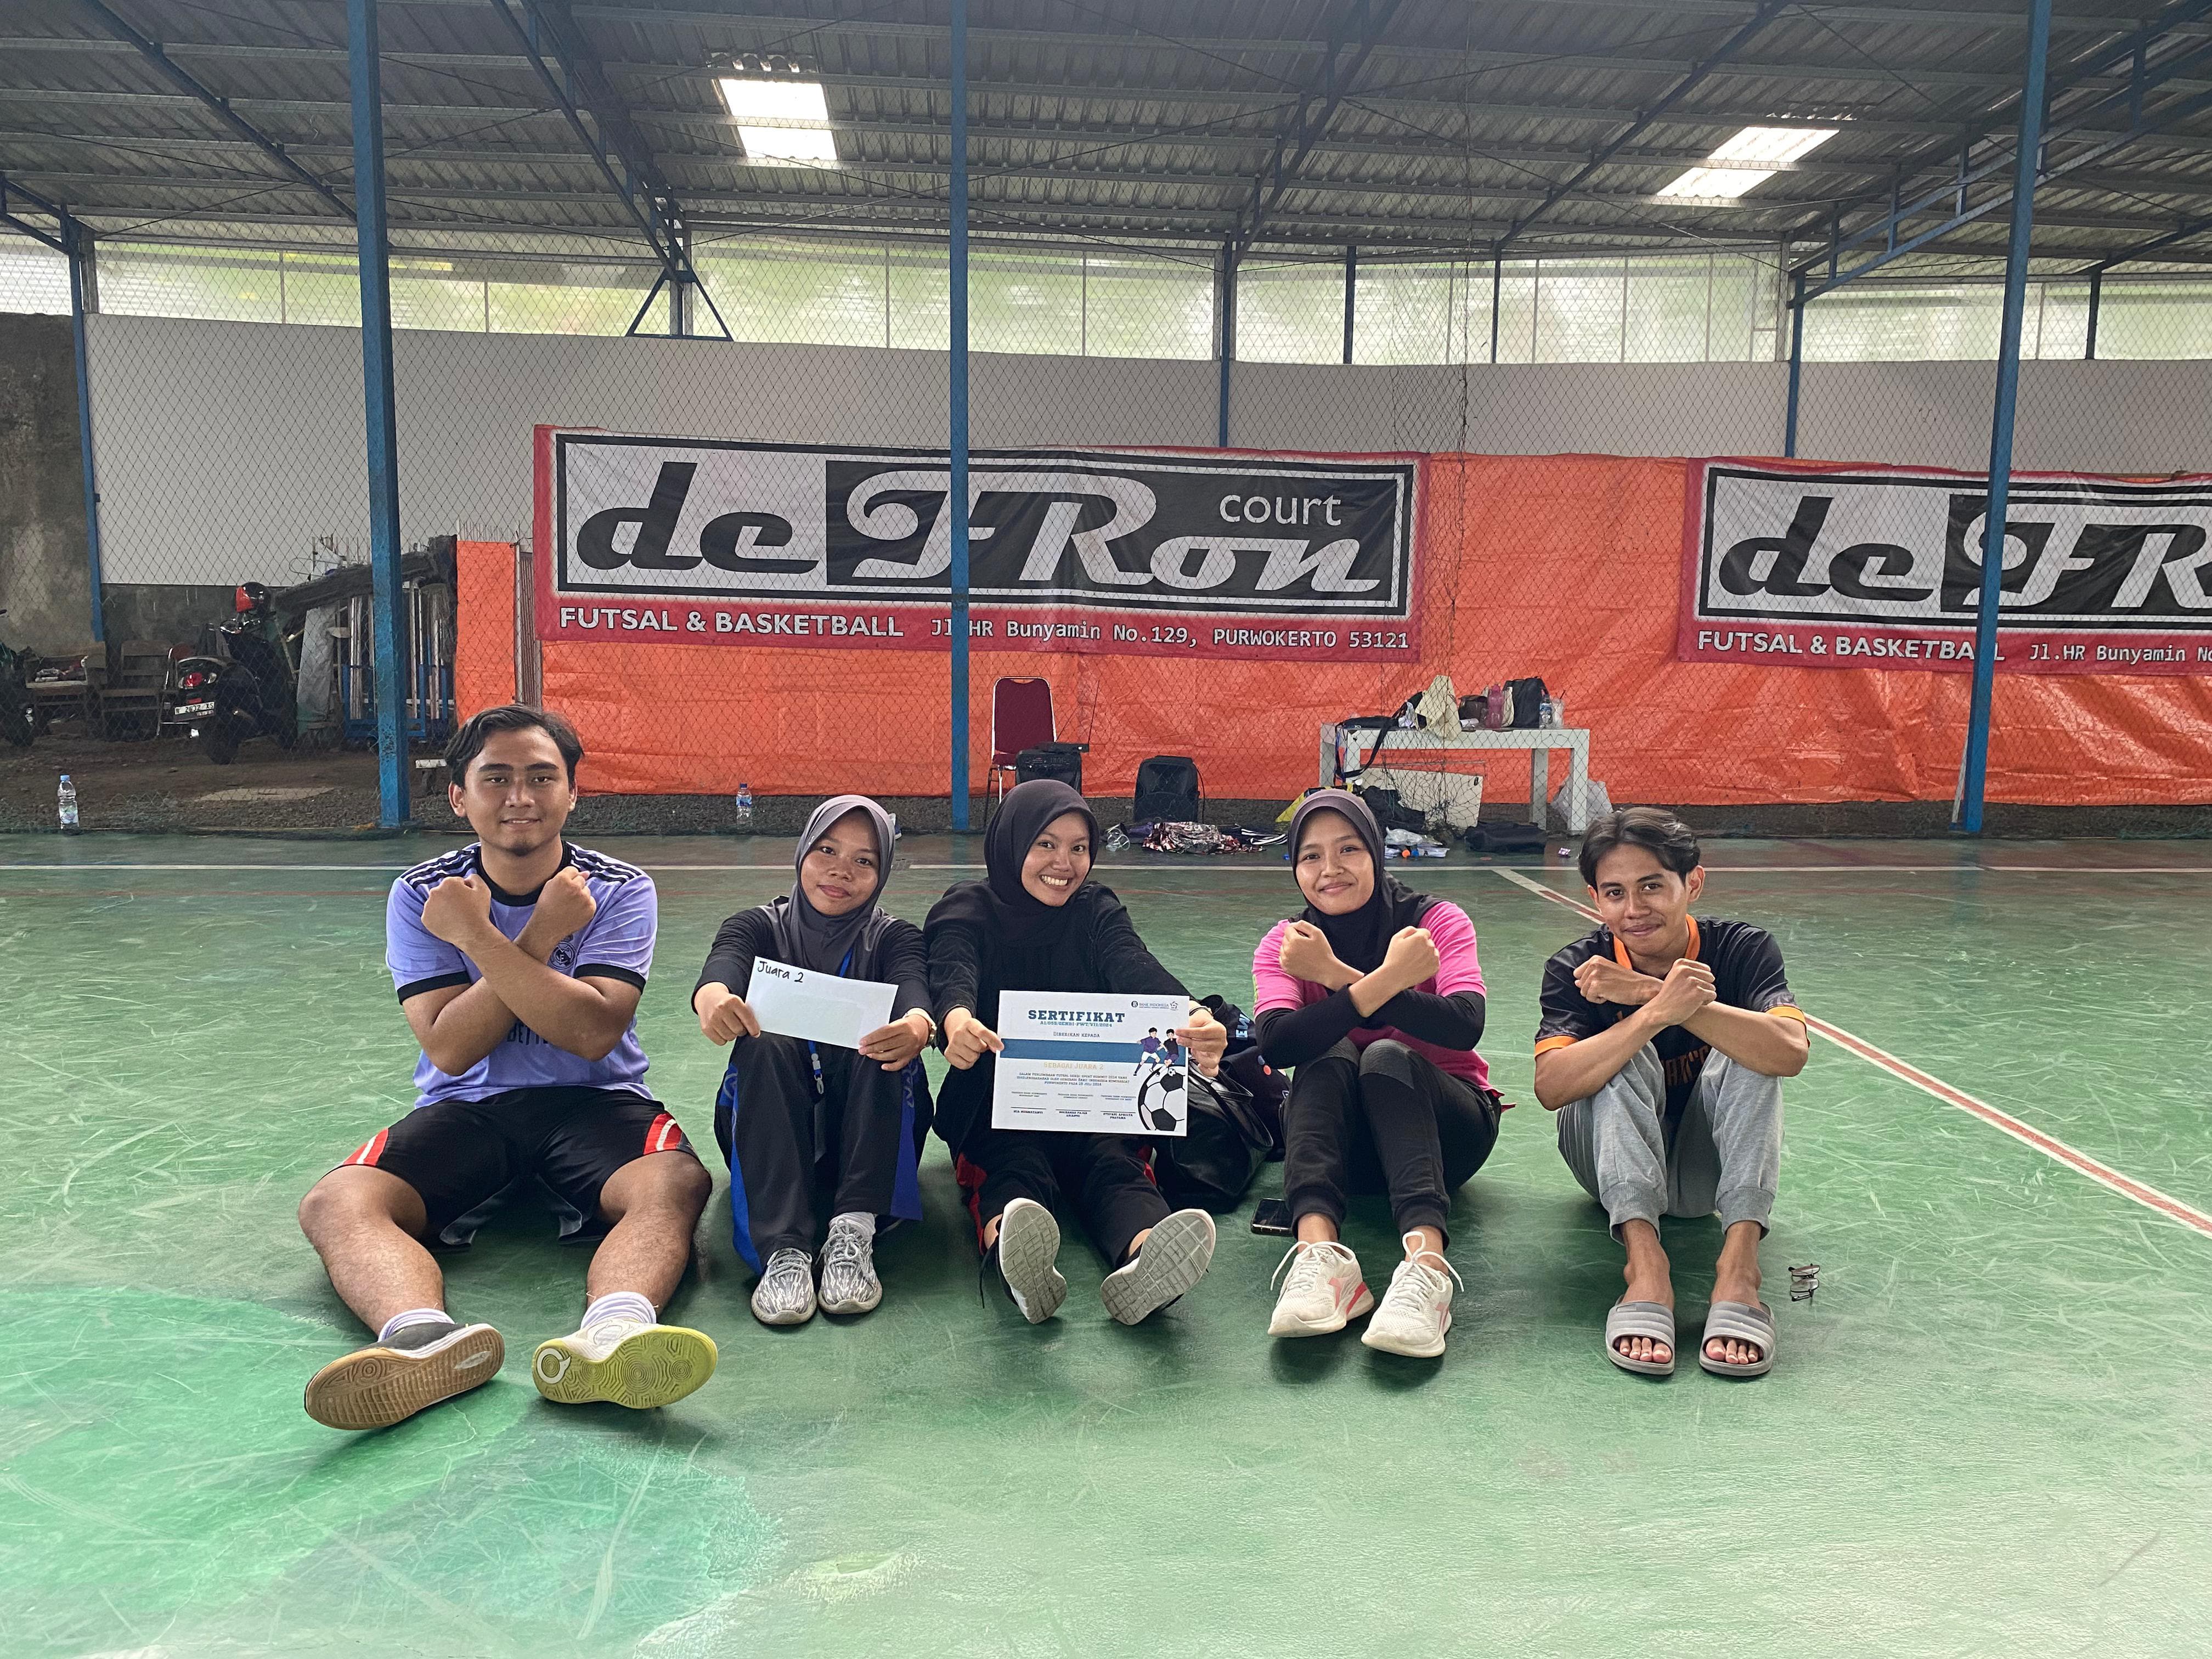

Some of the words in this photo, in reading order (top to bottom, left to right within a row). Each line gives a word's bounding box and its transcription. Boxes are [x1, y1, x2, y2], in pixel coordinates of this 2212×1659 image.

[1220, 493, 1342, 526] court
[560, 607, 678, 631] FUTSAL
[686, 611, 707, 632] &
[715, 612, 904, 637] BASKETBALL
[931, 618, 994, 636] JlHR
[1006, 620, 1101, 641] Bunyamin
[1113, 624, 1197, 648] No.129,
[1214, 628, 1337, 647] PURWOKERTO
[1348, 631, 1409, 648] 53121
[1698, 630, 1803, 654] FUTSAL
[1810, 635, 1827, 654] &
[1835, 636, 2006, 661] BASKETBAL
[2096, 645, 2186, 665] Bunyamin
[757, 961, 791, 979] Juara
[794, 972, 804, 983] 2
[1028, 1009, 1125, 1023] SERTIFIKAT
